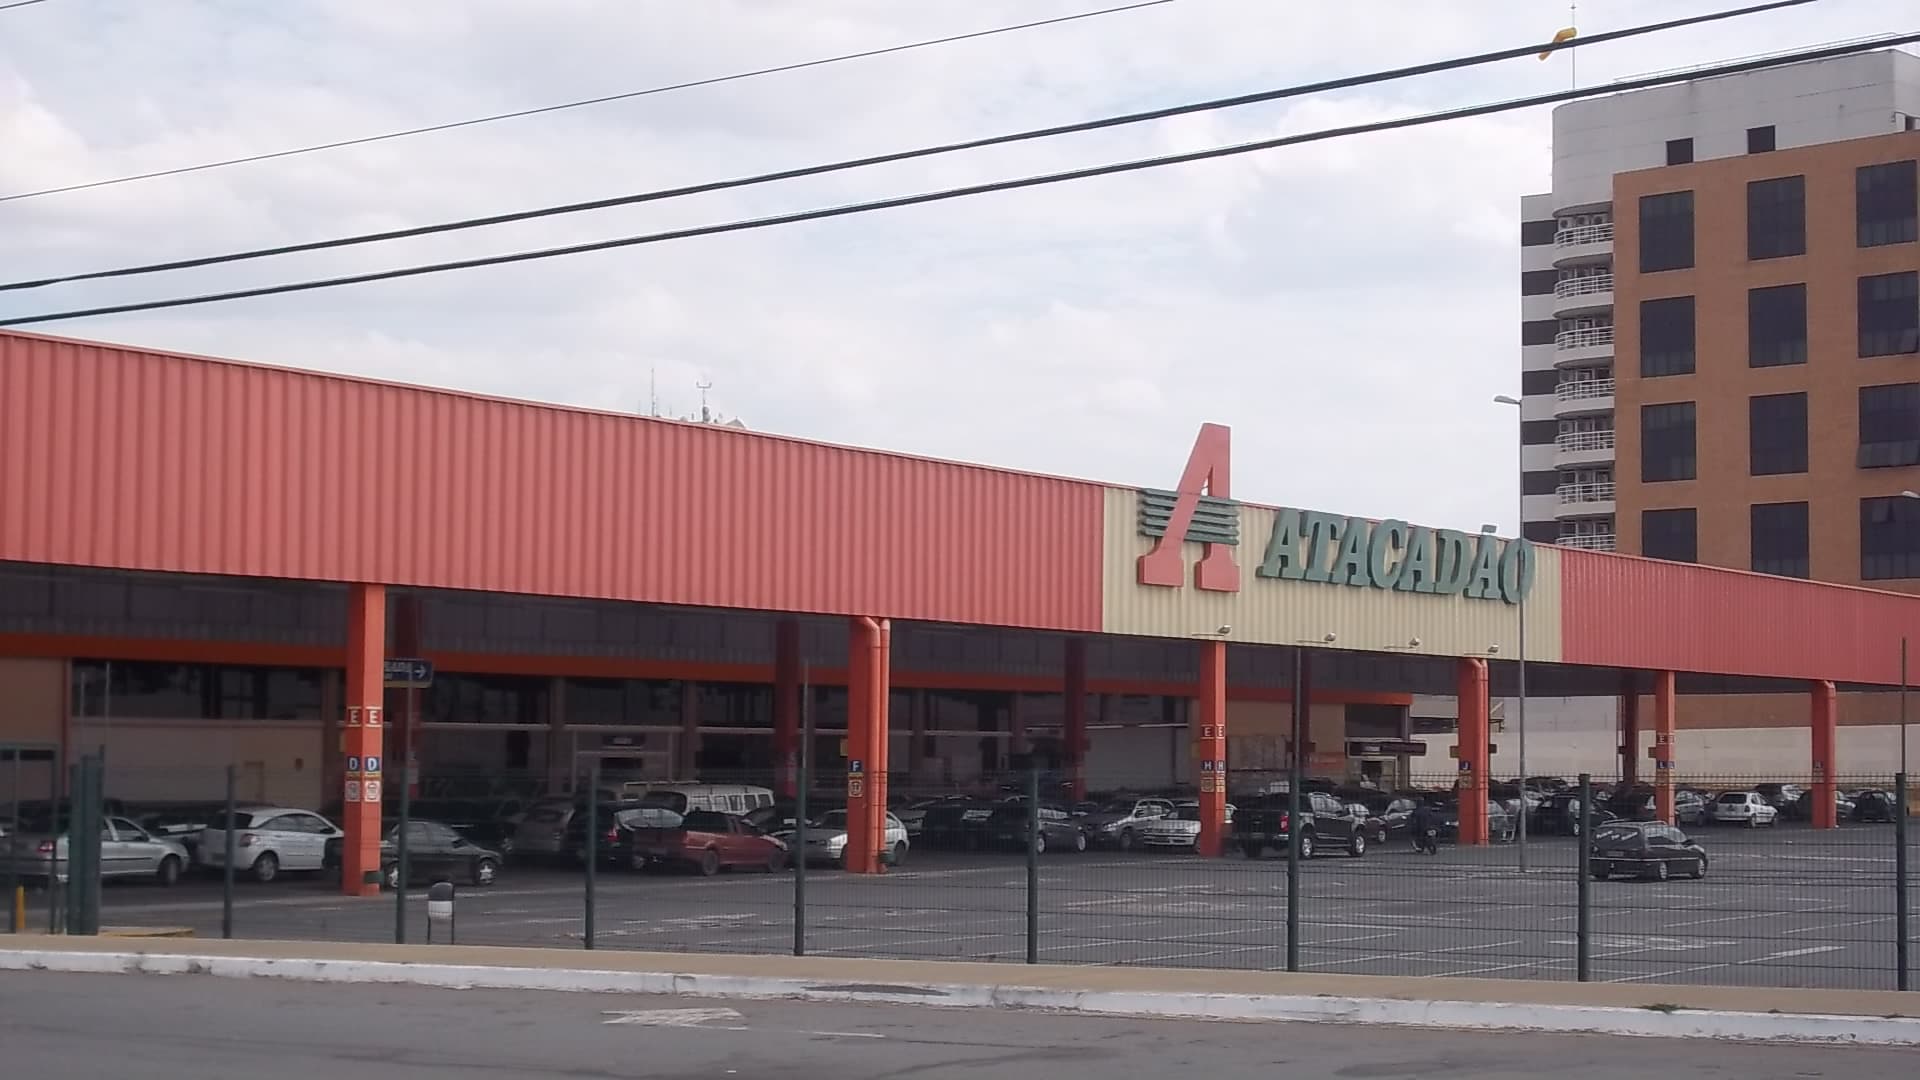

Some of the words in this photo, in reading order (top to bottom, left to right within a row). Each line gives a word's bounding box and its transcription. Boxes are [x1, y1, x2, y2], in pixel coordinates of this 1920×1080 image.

[1256, 507, 1535, 604] ATACADÃO
[351, 711, 359, 724] E
[369, 713, 378, 724] E
[1205, 727, 1212, 737] E
[1218, 727, 1224, 737] E
[349, 758, 359, 771] D
[367, 758, 377, 771] D
[853, 761, 860, 771] F
[1204, 761, 1212, 770] H
